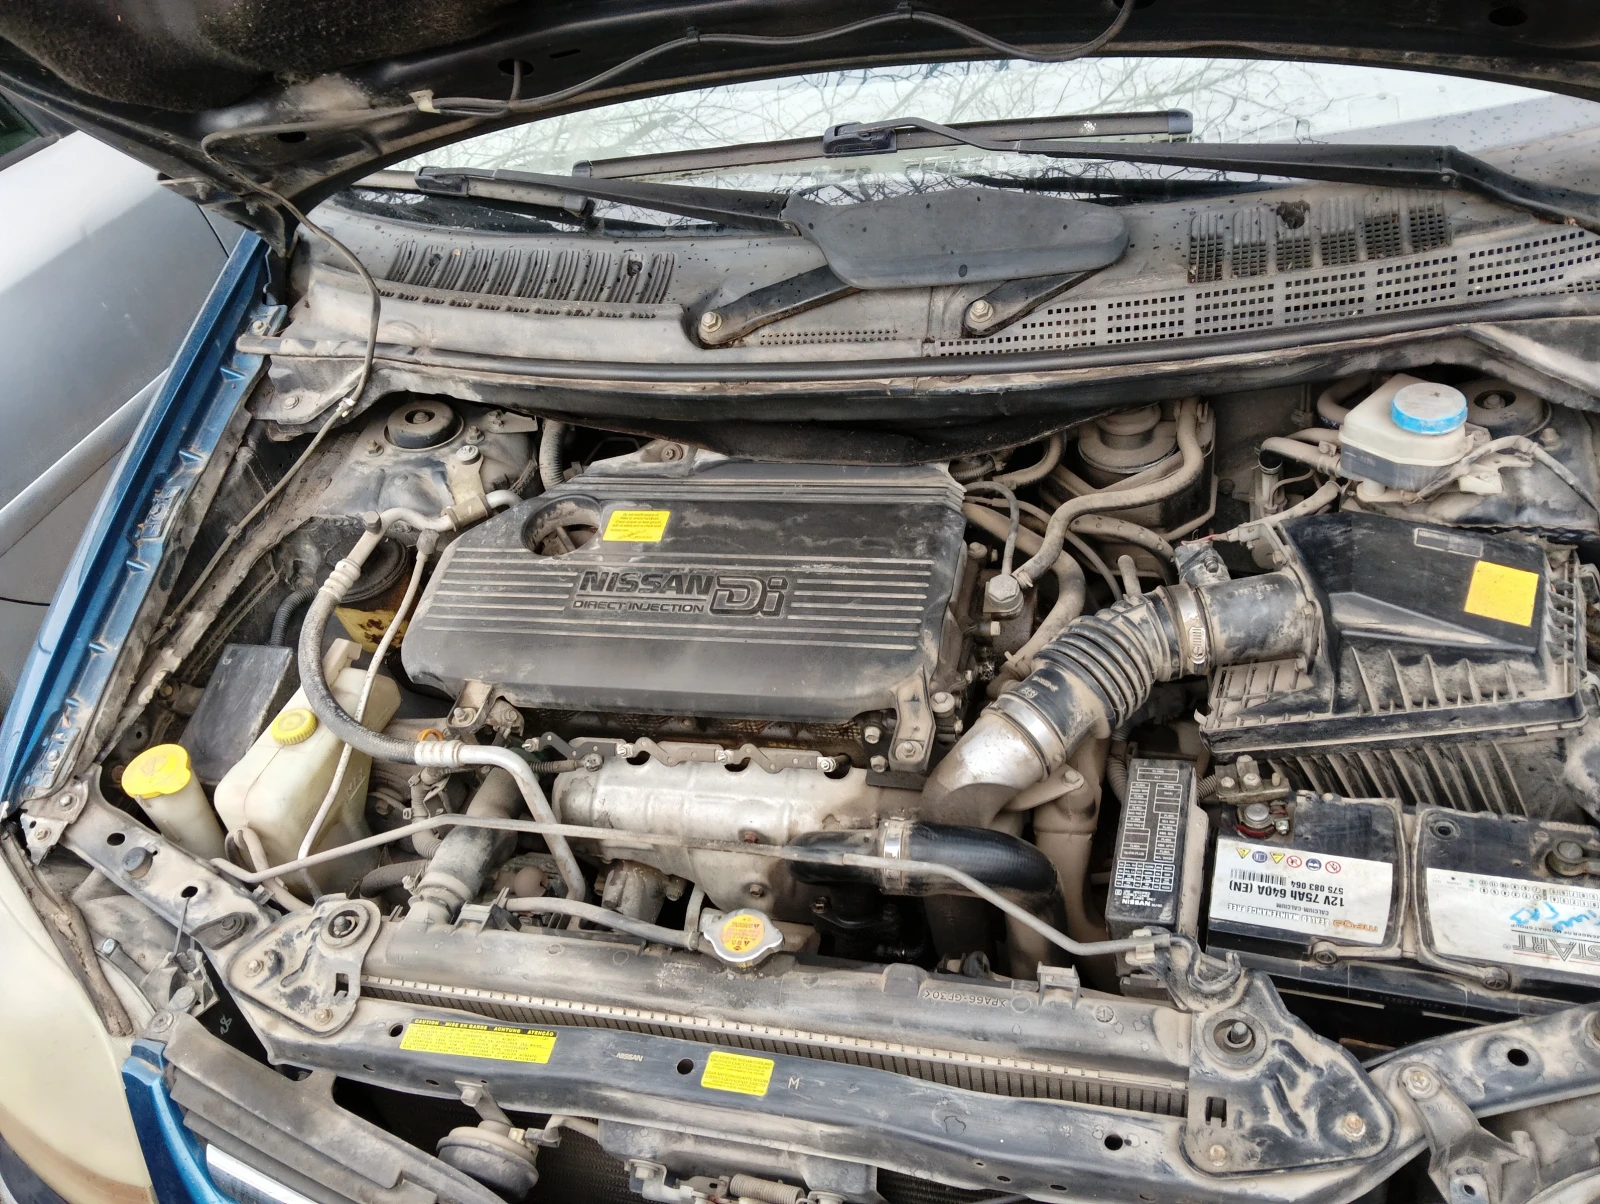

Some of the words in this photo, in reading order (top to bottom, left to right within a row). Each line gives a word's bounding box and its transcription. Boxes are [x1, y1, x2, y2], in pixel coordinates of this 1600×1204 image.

[578, 570, 714, 596] NISSAN
[708, 575, 788, 618] Di
[572, 600, 626, 611] DIRECT
[627, 602, 705, 614] INJECTION
[1229, 880, 1253, 893] (EN)
[1290, 880, 1307, 889] 064
[1309, 883, 1325, 892] 083
[1328, 886, 1344, 895] 575
[1257, 884, 1286, 898] 640A
[1290, 889, 1320, 903] 75Ah
[1122, 898, 1150, 907] NISSAN
[1323, 895, 1344, 907] 12V
[1228, 903, 1246, 912] FREE
[1247, 905, 1300, 921] MAINTENANCE
[1276, 903, 1329, 915] CALCIUM-CALCIUM
[1302, 915, 1330, 926] SEALED
[527, 1029, 554, 1037] ATENÇÃO
[616, 1052, 644, 1062] NISSAN
[787, 1076, 800, 1090] M
